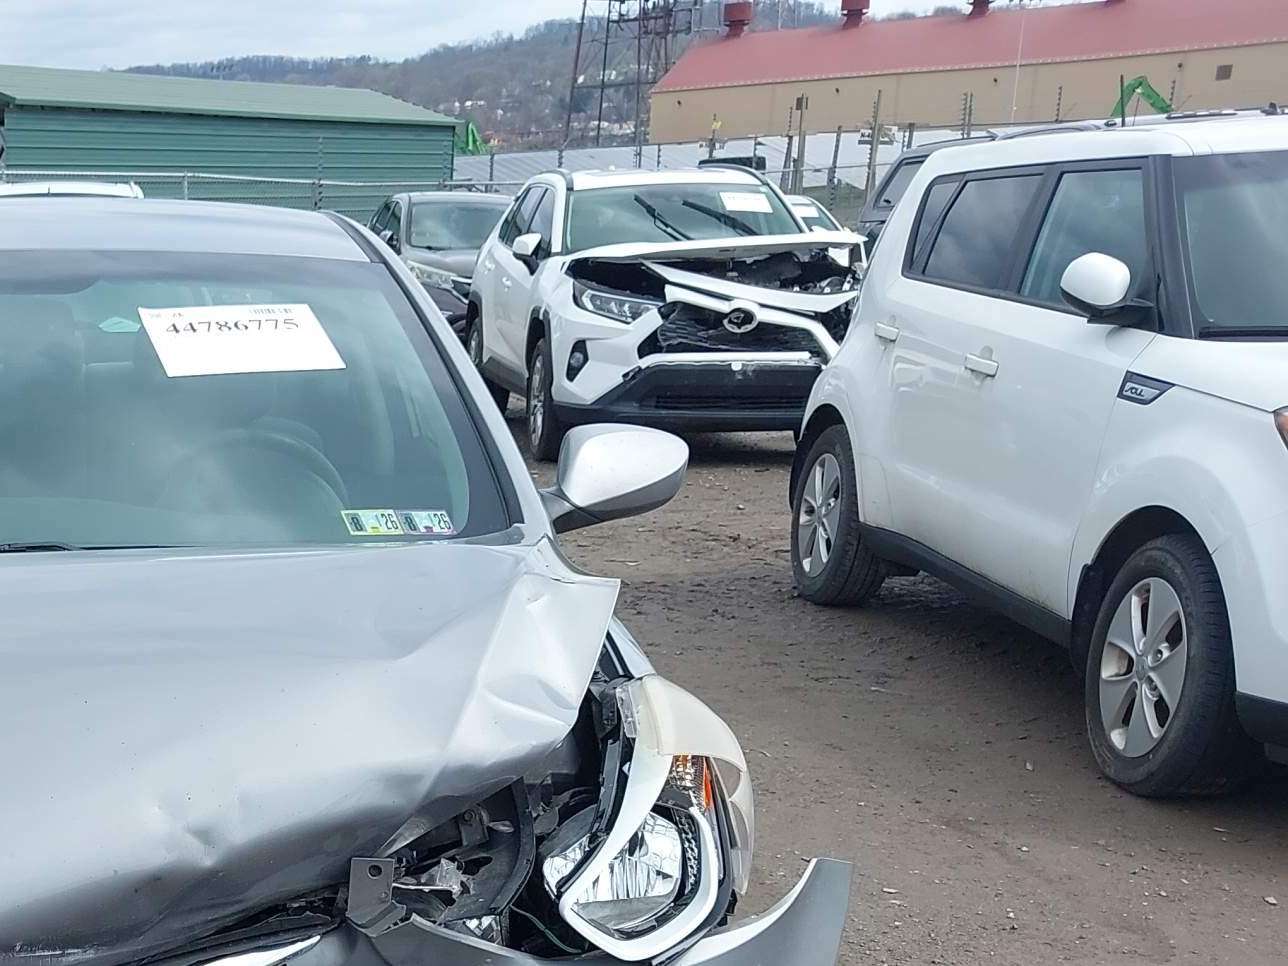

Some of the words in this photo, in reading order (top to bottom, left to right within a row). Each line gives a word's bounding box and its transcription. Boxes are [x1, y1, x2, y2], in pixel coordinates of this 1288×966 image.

[165, 318, 300, 334] 44786775
[380, 513, 399, 530] 26
[433, 513, 452, 530] 26
